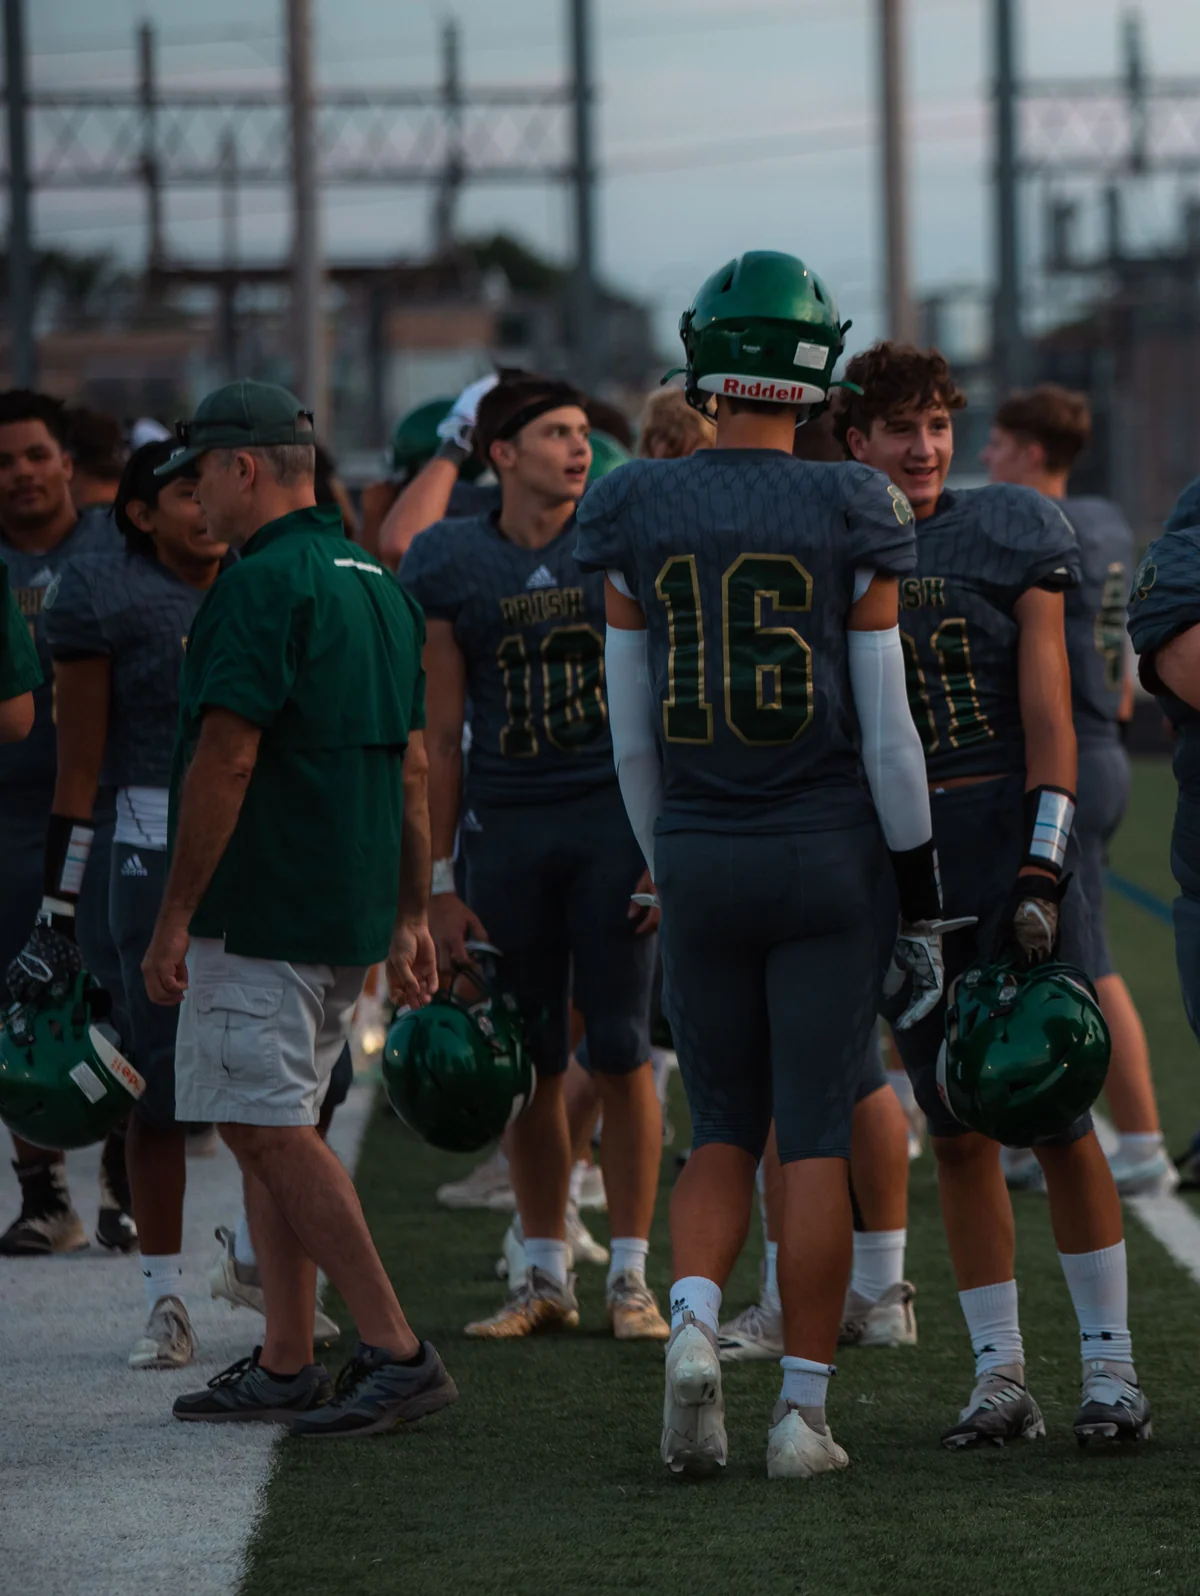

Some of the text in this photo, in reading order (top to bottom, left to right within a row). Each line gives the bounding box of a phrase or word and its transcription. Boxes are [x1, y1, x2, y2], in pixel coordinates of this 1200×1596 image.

[723, 378, 803, 400] Riddell
[500, 587, 583, 627] IRISH
[655, 552, 814, 746] 16
[497, 622, 607, 757] 10
